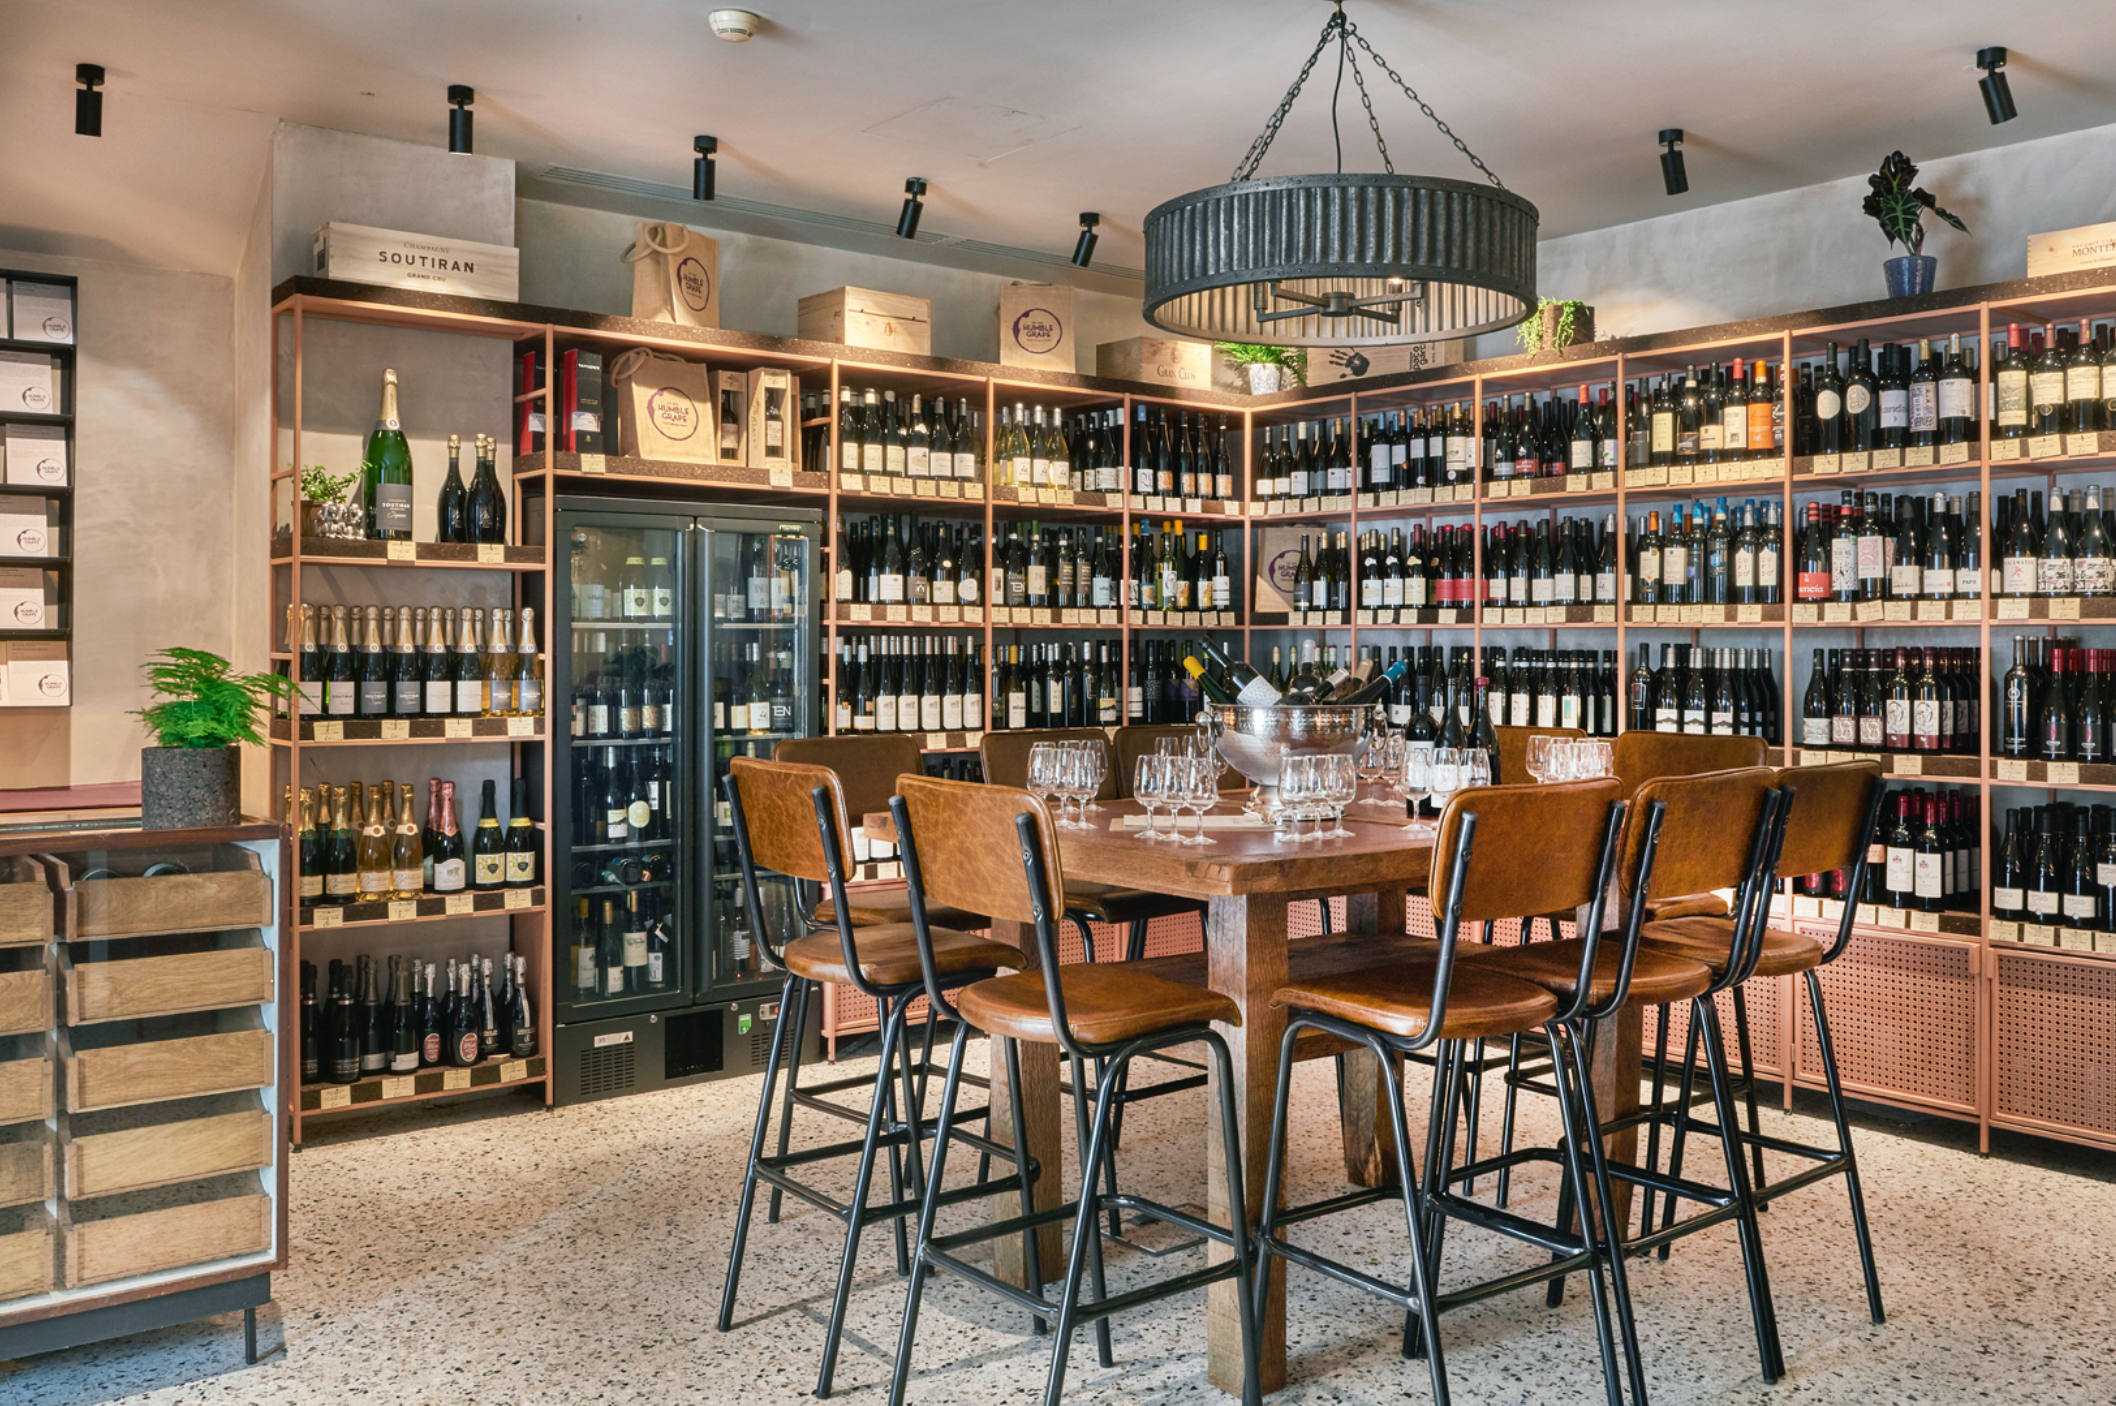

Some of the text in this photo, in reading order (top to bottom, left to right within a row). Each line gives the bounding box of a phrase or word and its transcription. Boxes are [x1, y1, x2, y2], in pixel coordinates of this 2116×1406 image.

[403, 241, 450, 254] CHAMPAGNE
[378, 251, 475, 274] SOUTIRAN
[406, 272, 447, 283] GRAND CRU
[1022, 324, 1054, 332] HUMBLE
[1025, 330, 1051, 339] GRAPE
[1420, 343, 1428, 366] garc
[1156, 364, 1196, 381] GRAN CLOS
[657, 403, 689, 415] HUMBLE
[661, 412, 687, 423] GRAPE
[771, 705, 791, 717] TEN
